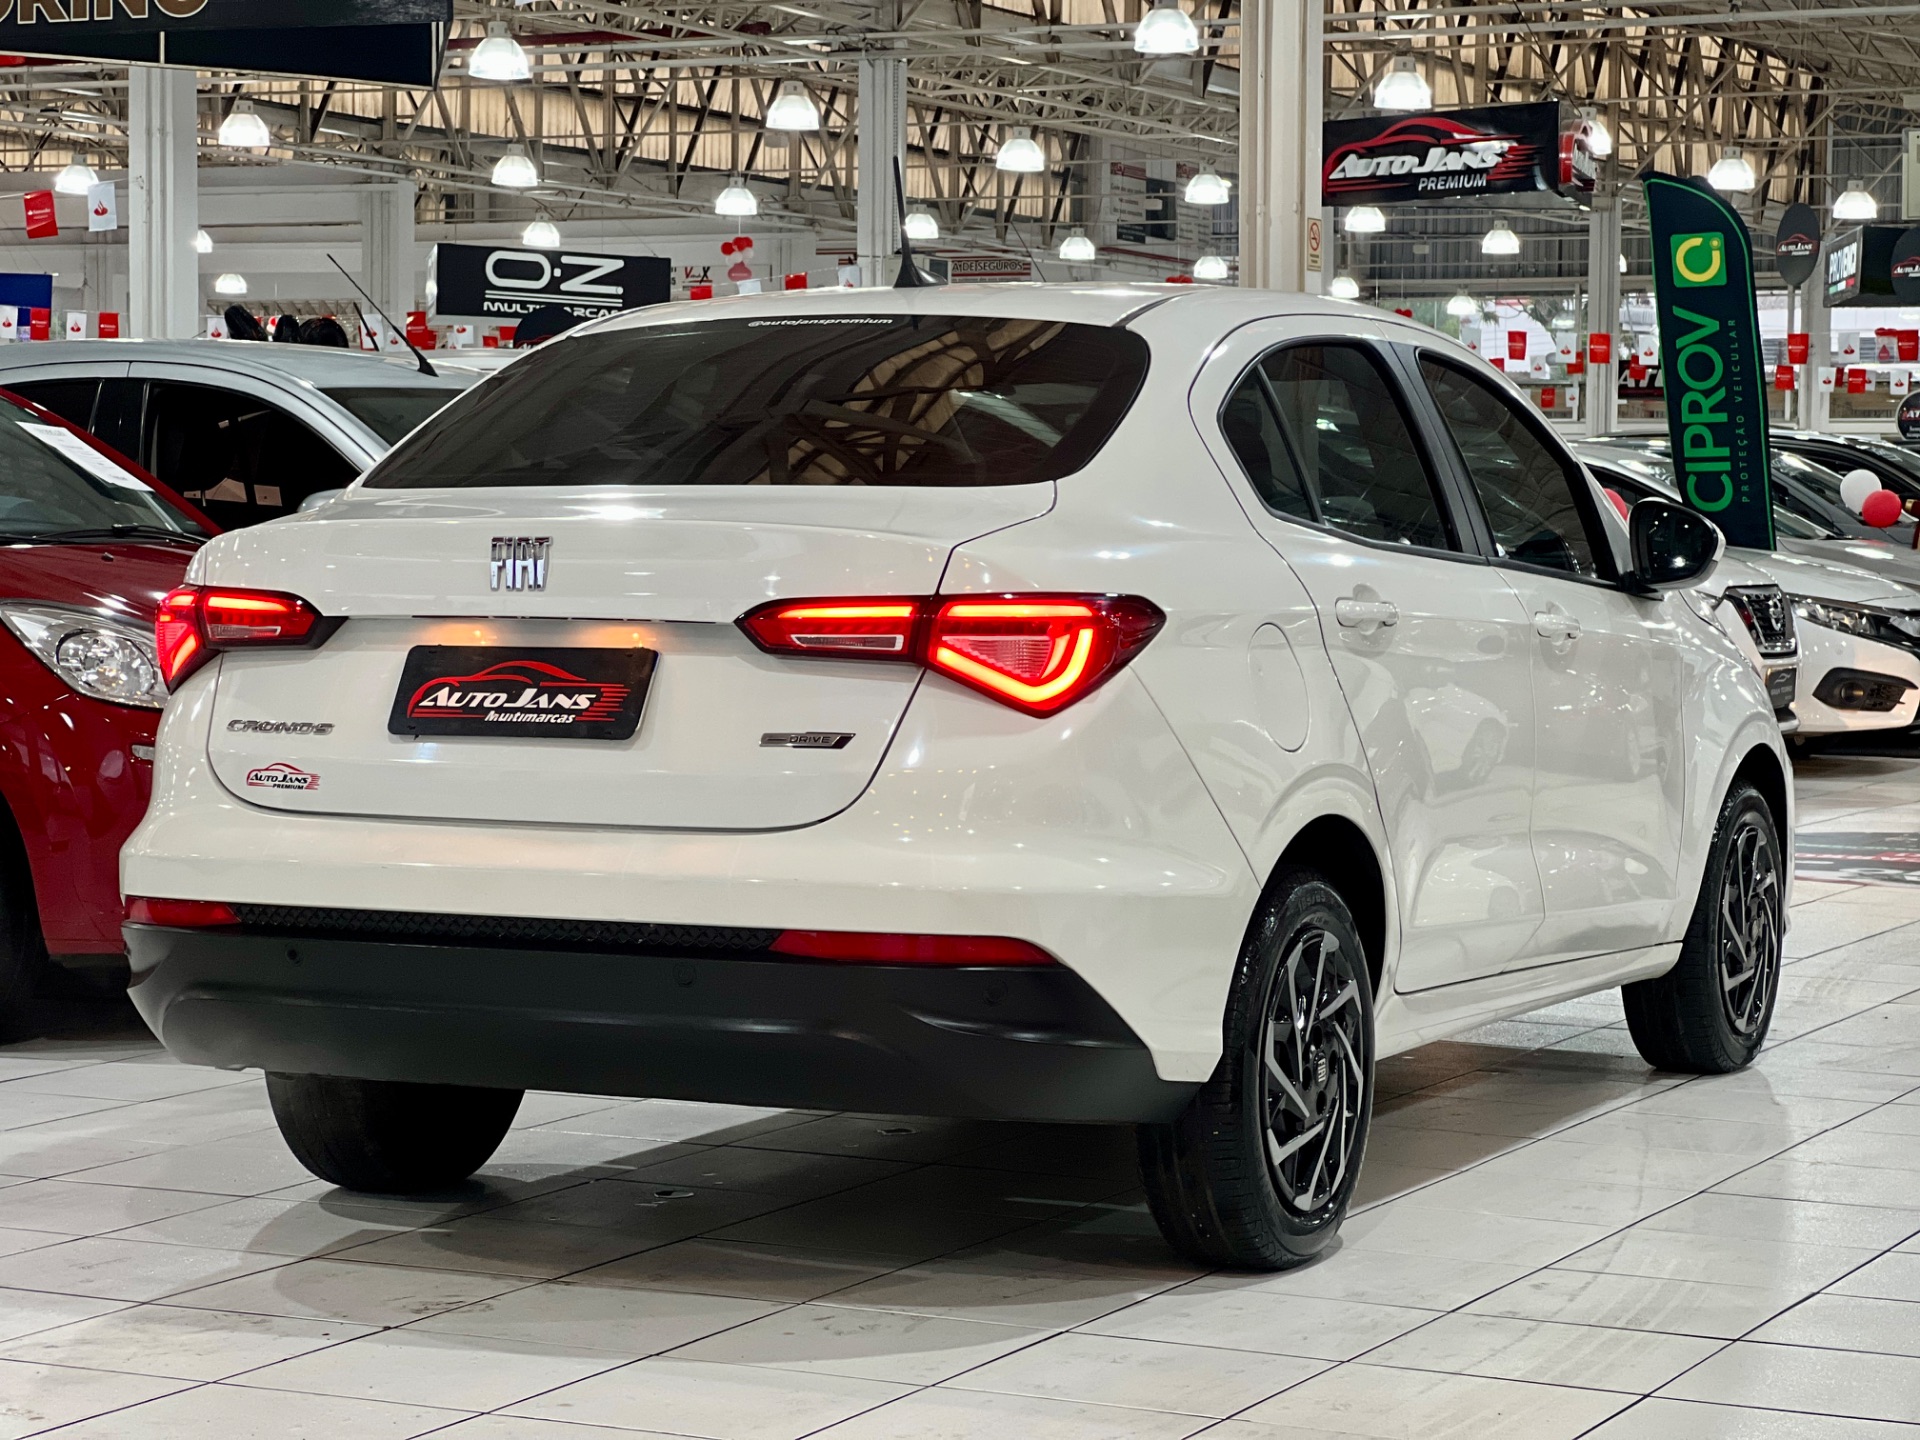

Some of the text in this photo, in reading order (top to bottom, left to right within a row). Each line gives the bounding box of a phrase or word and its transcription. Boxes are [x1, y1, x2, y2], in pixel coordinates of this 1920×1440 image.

[1417, 174, 1487, 191] PREMIUM
[977, 260, 1023, 271] SEGUROS
[747, 318, 894, 328] @autojanspremium
[1672, 305, 1734, 512] CIPROV
[1728, 320, 1750, 502] PROTEÇÃO VEICULAR
[490, 536, 553, 591] FIAT
[484, 710, 576, 724] Multimarcas
[226, 719, 335, 736] CRONOS
[788, 735, 832, 744] DRIVE
